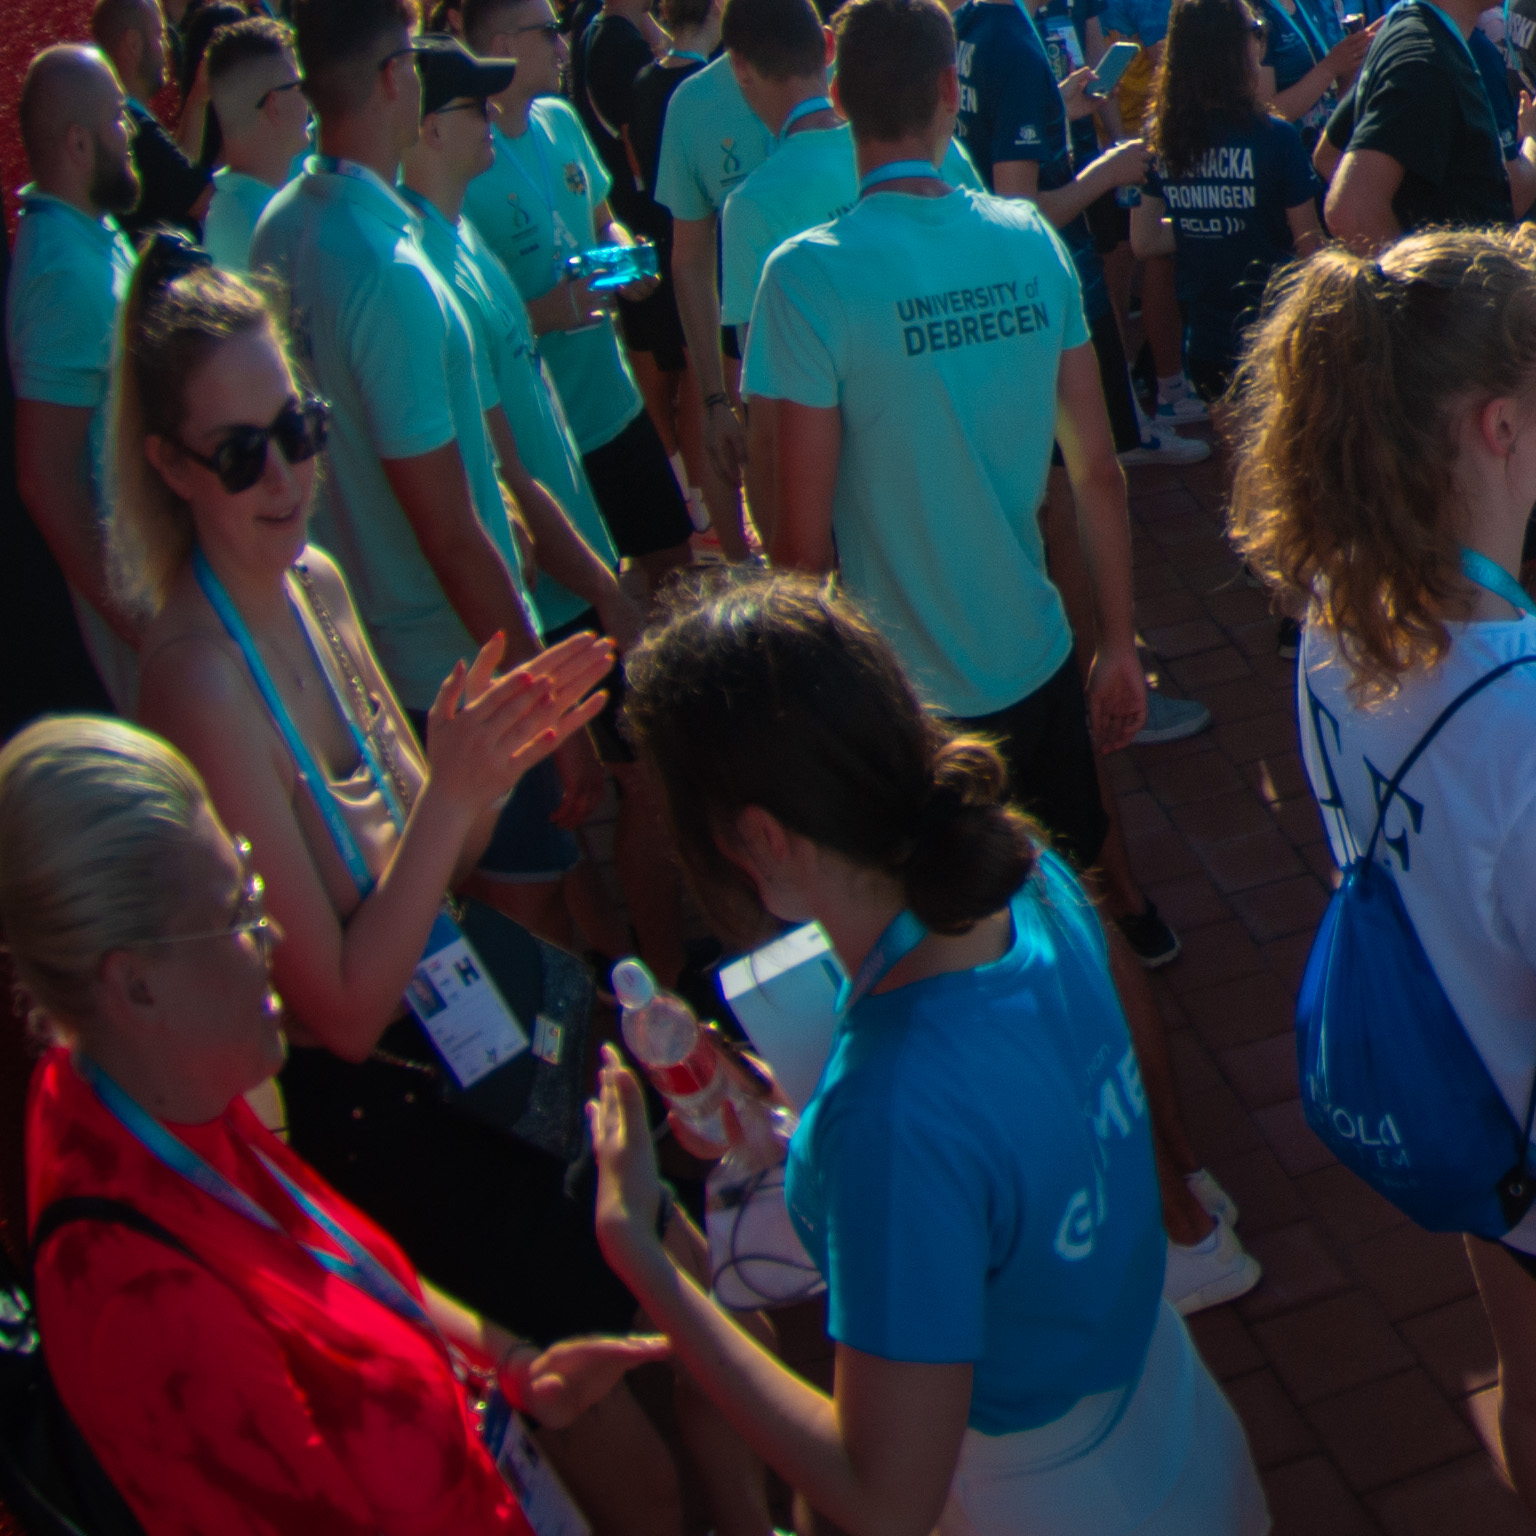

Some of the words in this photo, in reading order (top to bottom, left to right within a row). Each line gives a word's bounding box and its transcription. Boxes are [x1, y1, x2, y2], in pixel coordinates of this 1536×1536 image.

[896, 280, 1018, 322] UNIVERSITY
[1025, 275, 1039, 299] of
[903, 302, 1050, 357] DEBRECEN
